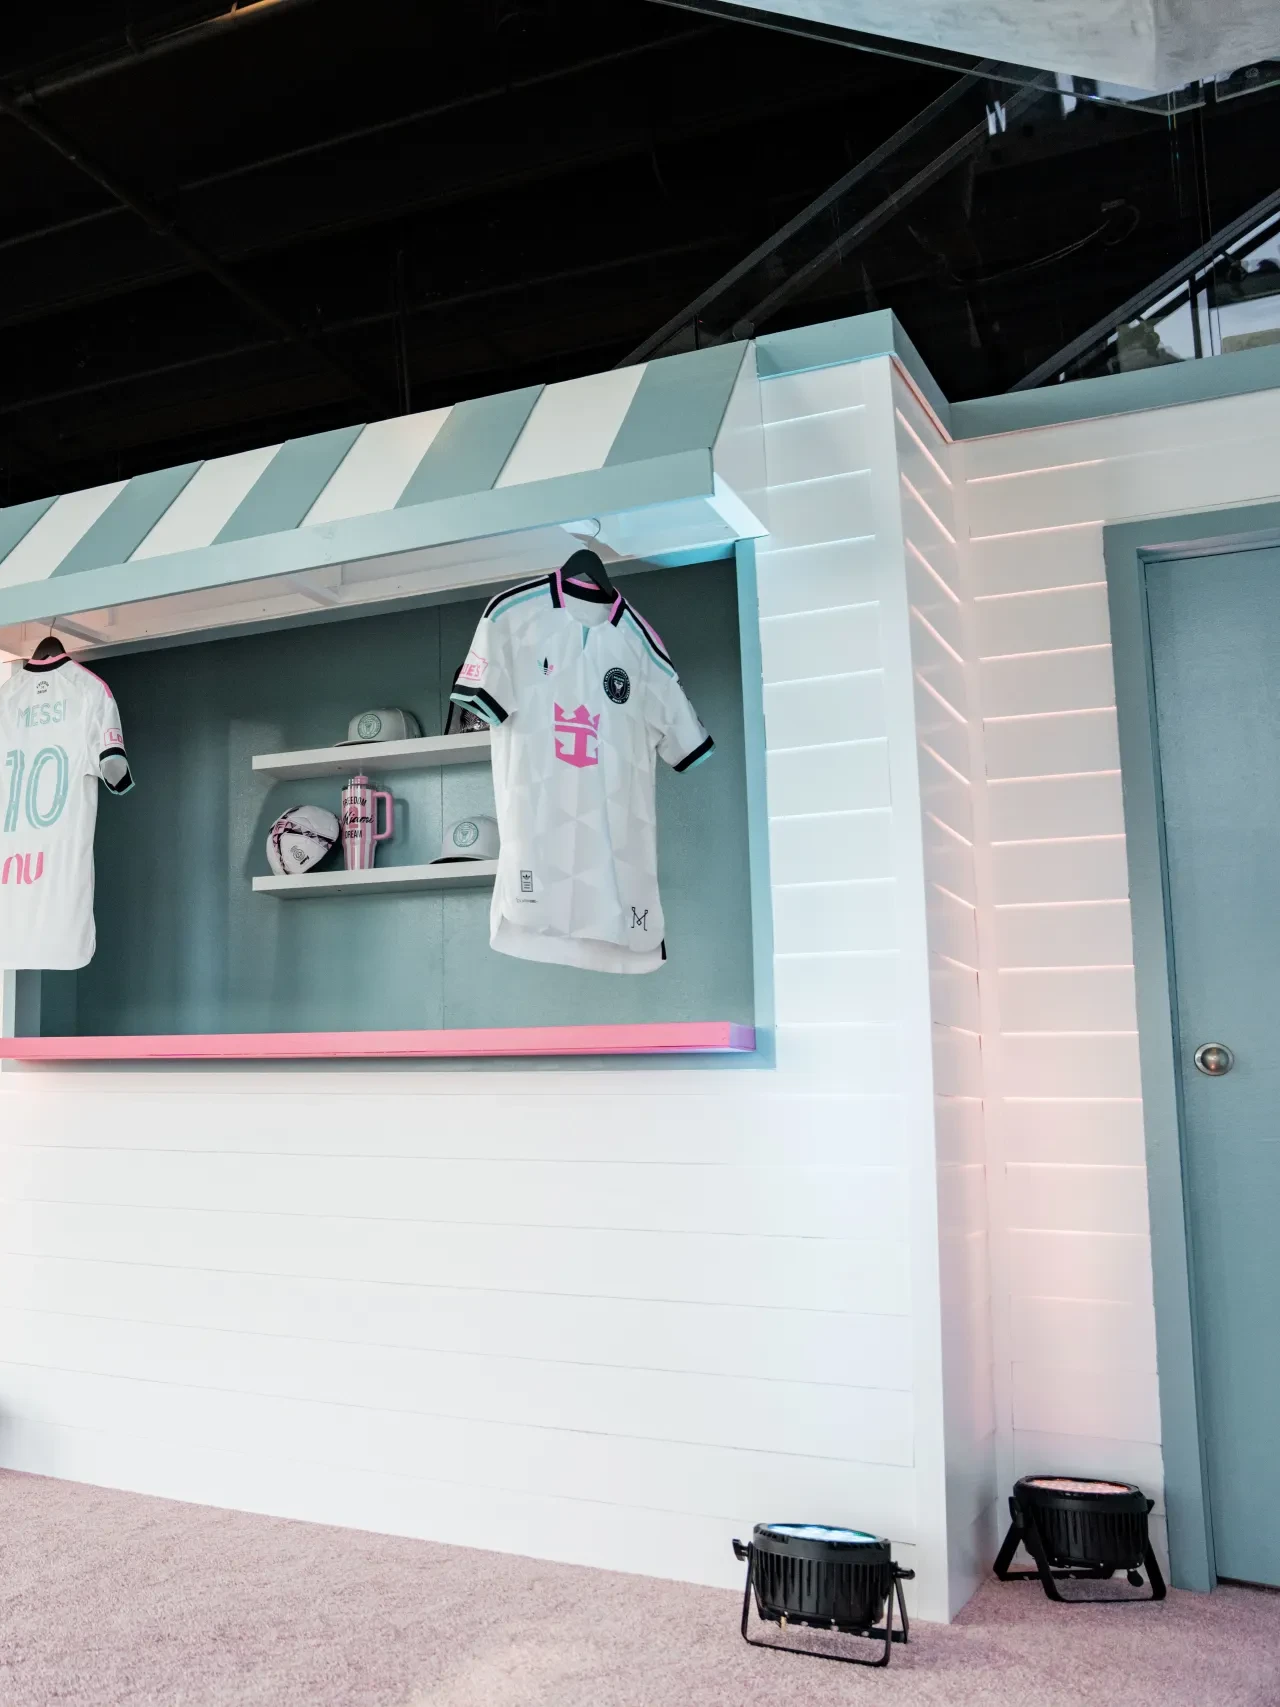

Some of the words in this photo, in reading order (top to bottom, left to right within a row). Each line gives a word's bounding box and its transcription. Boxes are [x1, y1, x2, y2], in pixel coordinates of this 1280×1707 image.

[16, 700, 67, 728] MESSI
[3, 744, 69, 833] 10
[343, 811, 375, 825] Miami
[345, 830, 363, 838] DREAM
